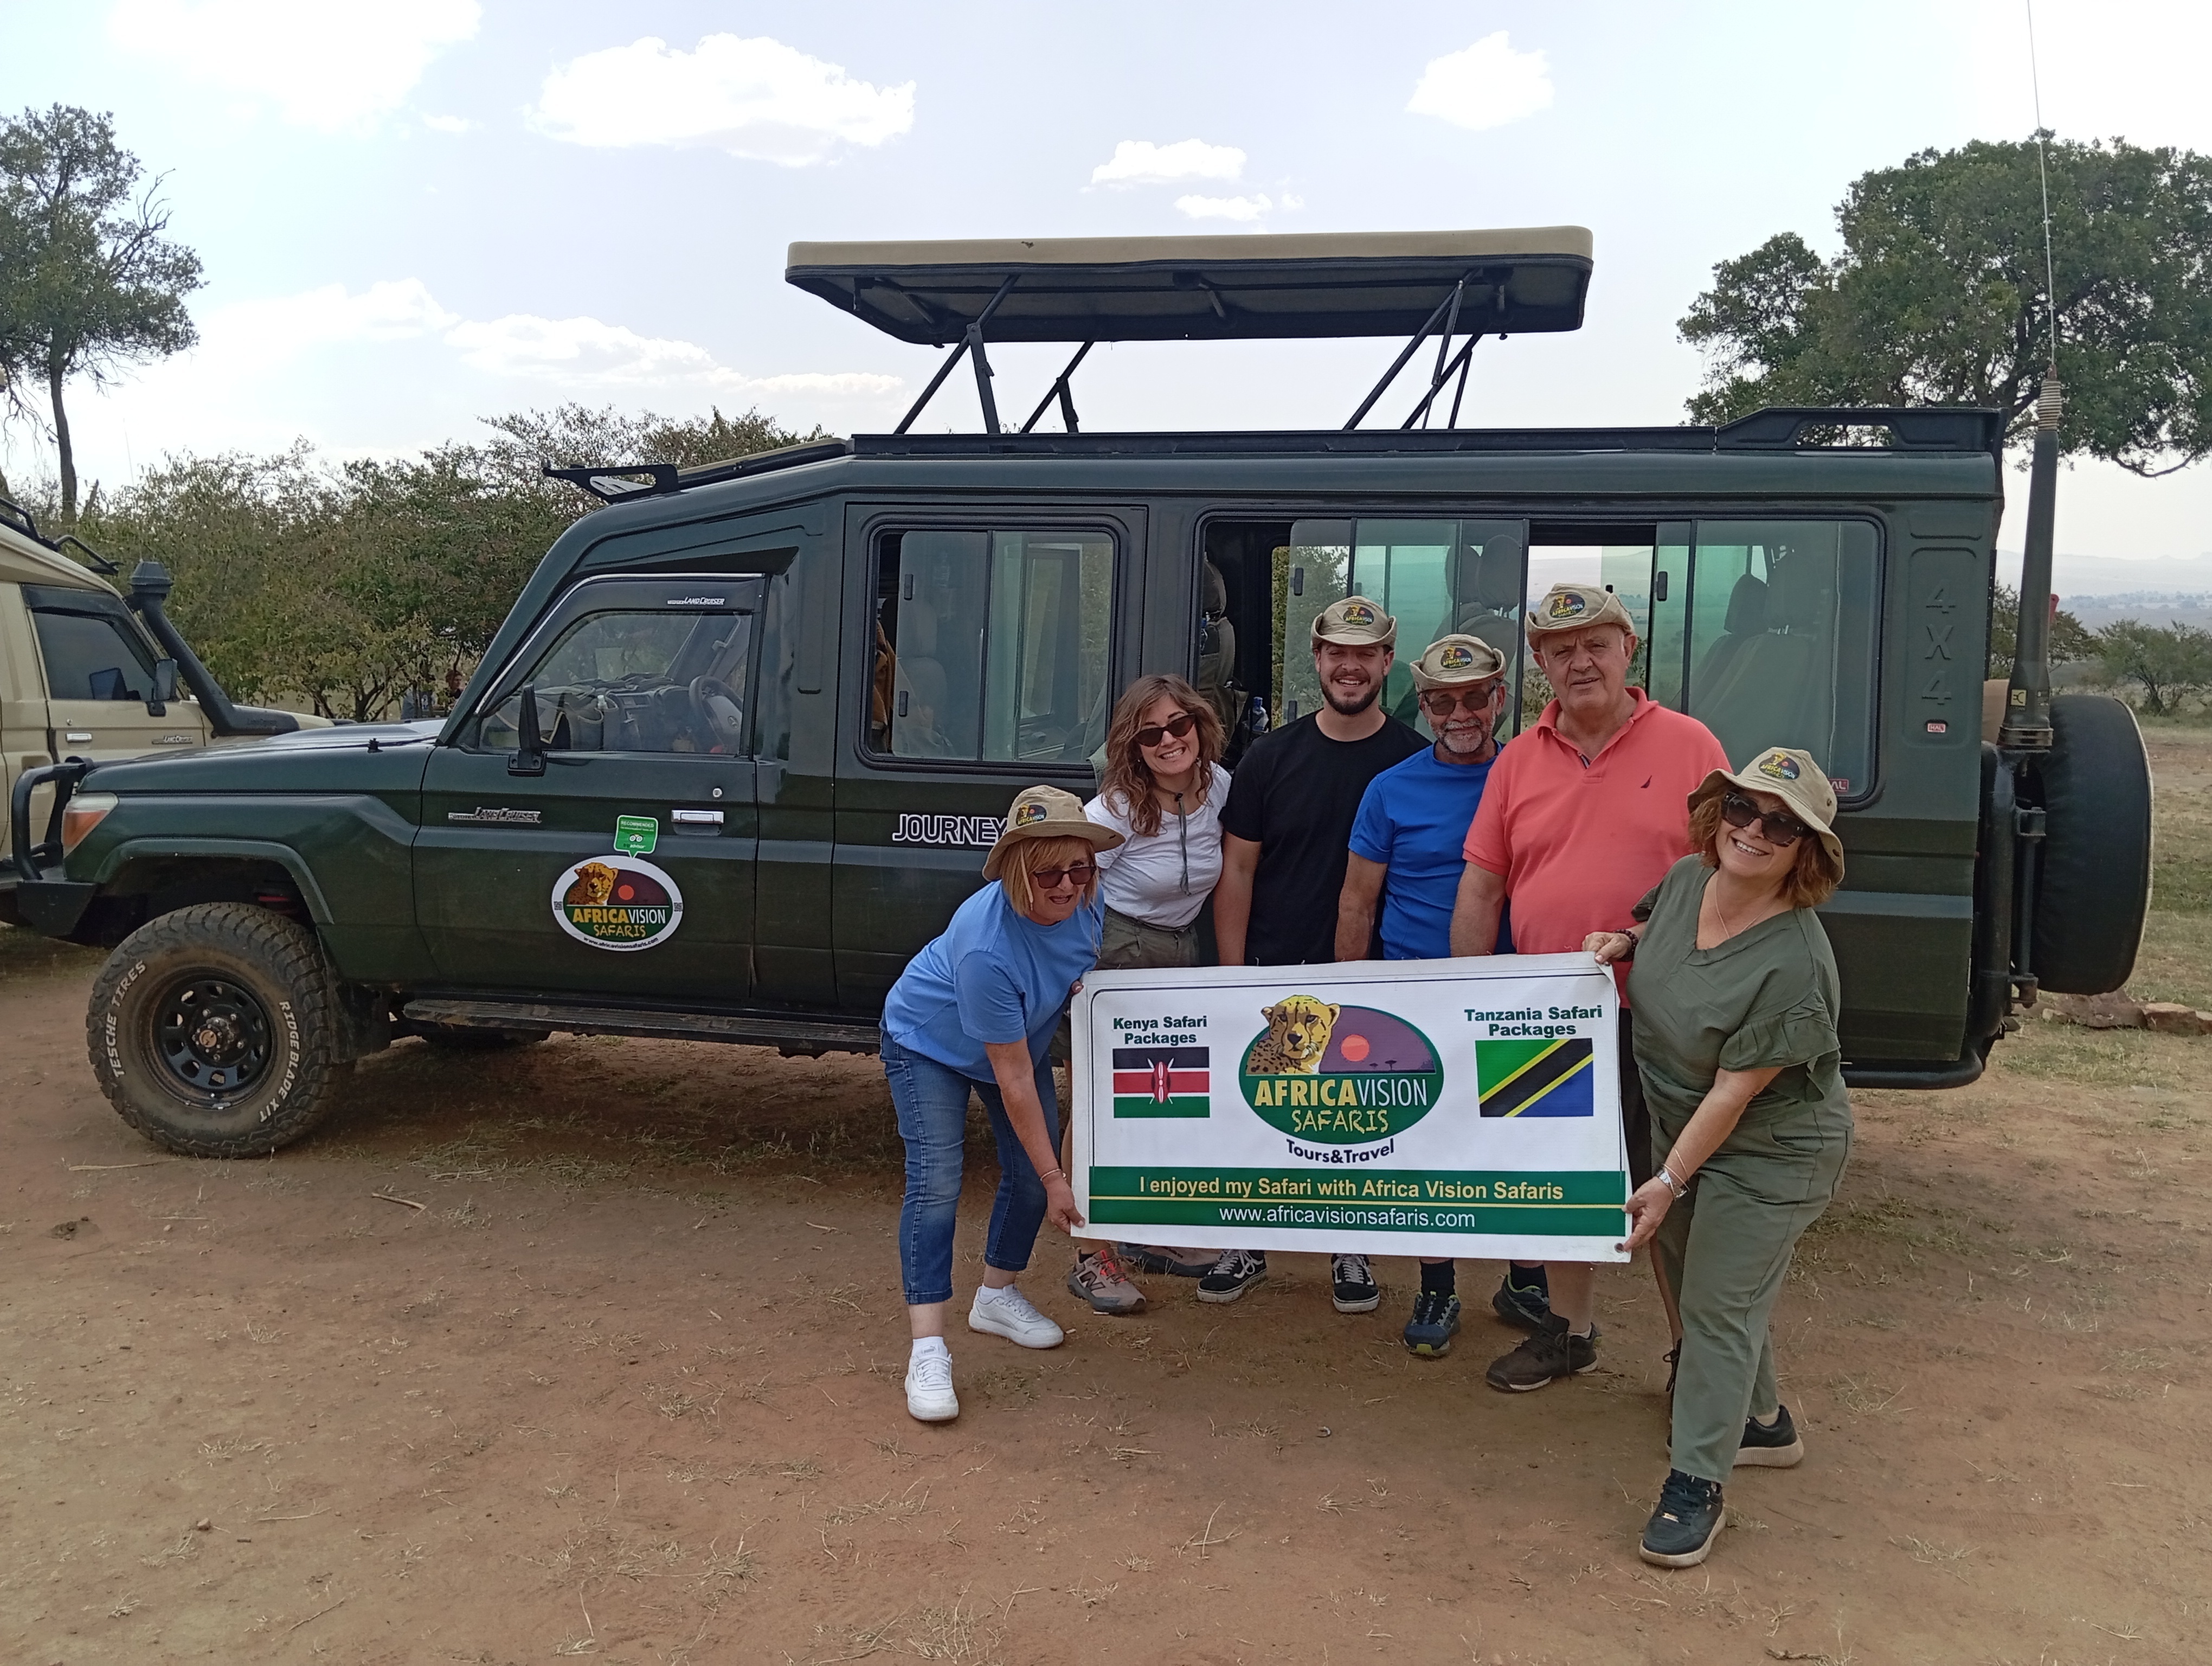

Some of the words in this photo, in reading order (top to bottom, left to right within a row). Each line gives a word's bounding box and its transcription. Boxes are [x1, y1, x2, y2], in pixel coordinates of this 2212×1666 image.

[892, 814, 1007, 845] JOURNEY
[594, 925, 646, 937] SAFARIS
[112, 960, 146, 1007] TIRES
[1114, 1018, 1159, 1031] Kenya
[1163, 1016, 1207, 1028] Safari
[1464, 1008, 1542, 1021] Tanzania
[1548, 1005, 1602, 1020] Safari
[1124, 1033, 1197, 1046] Packages
[1489, 1023, 1577, 1038] Packages
[106, 1013, 125, 1078] TESCHE
[1291, 1109, 1389, 1134] SAFARIS
[1286, 1138, 1394, 1164] Tours&Travel
[1140, 1176, 1144, 1192] I
[1150, 1177, 1220, 1196] enjoyed
[1225, 1181, 1252, 1198] my
[1258, 1178, 1311, 1195] Safari
[1317, 1179, 1356, 1196] with
[1361, 1180, 1419, 1197] Africa
[1425, 1181, 1487, 1198] Vision
[1493, 1181, 1564, 1200] Safaris
[1219, 1205, 1475, 1227] www.africavisionsafaris.com
